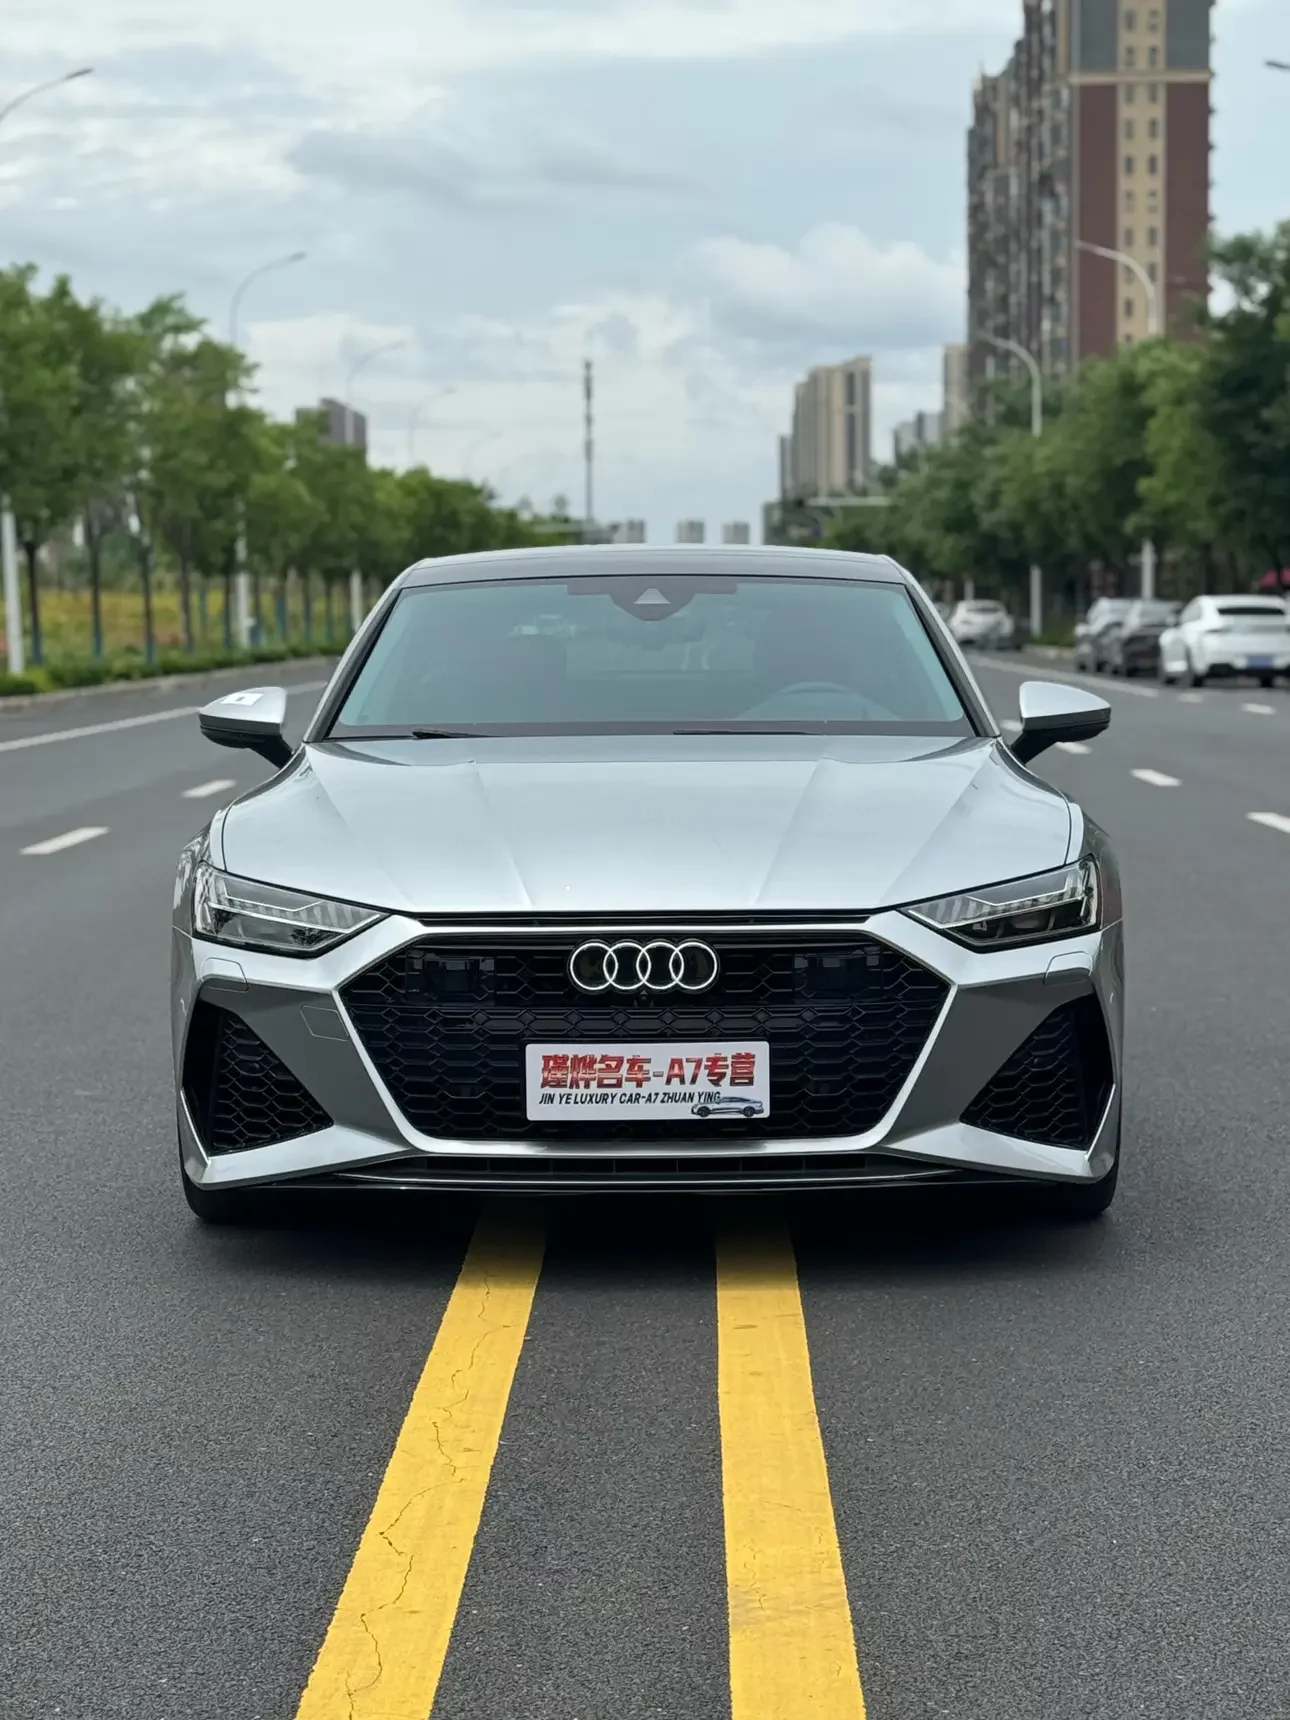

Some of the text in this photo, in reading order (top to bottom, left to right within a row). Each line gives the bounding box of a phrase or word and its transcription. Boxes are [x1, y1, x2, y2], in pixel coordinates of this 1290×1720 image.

[539, 1091, 721, 1105] JIN YE LUXURY CAR-A7 ZHUAN YING
